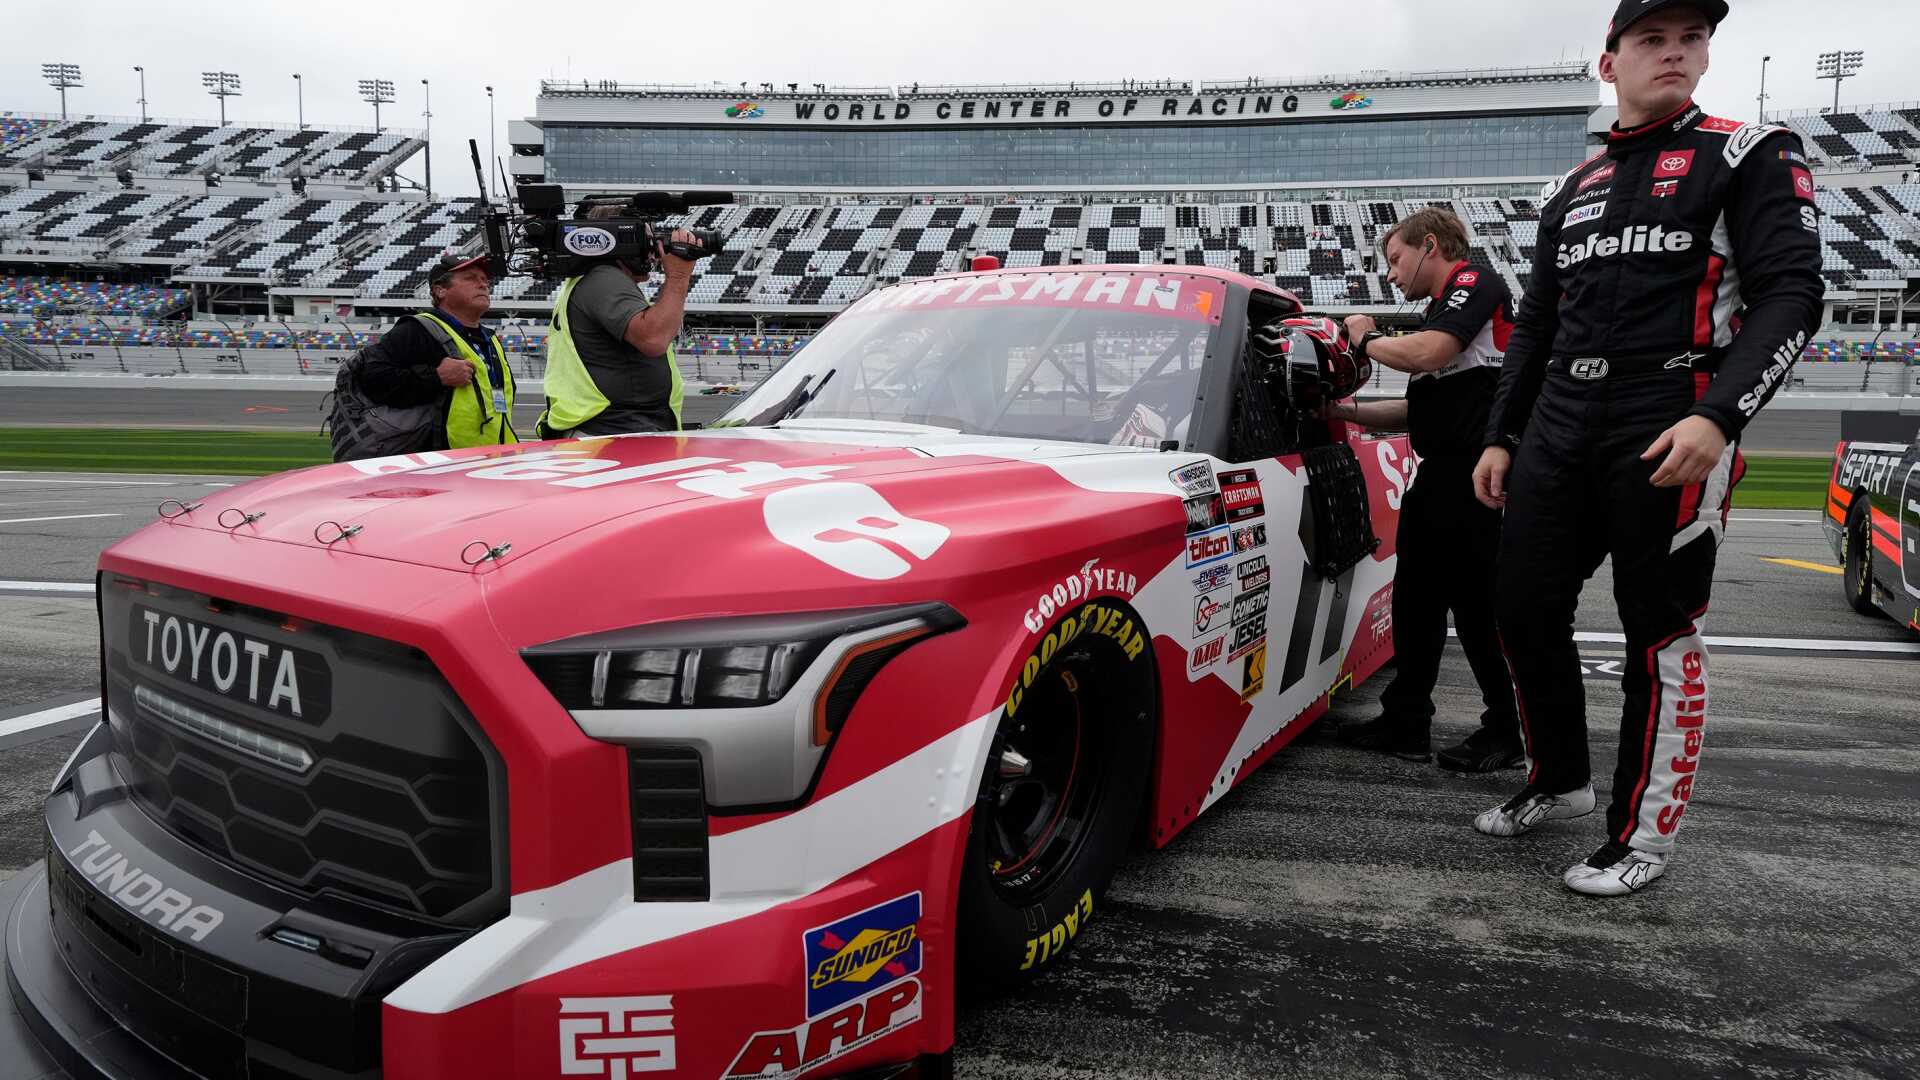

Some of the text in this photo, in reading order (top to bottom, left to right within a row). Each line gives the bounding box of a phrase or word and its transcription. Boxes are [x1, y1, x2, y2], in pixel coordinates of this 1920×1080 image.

[795, 95, 1298, 120] WORLD CENTER OF RACING
[578, 234, 601, 244] FOX
[1556, 224, 1693, 269] Safelite
[1738, 330, 1806, 416] Safelite
[1224, 486, 1260, 504] CRAFTSMAN
[1188, 536, 1230, 561] tilton
[1238, 557, 1266, 578] LINCOLN
[1024, 558, 1137, 634] GOODYEAR
[1233, 590, 1269, 620] COMETIC
[1244, 572, 1269, 590] WELDERS
[1228, 613, 1267, 654] JESEL
[144, 610, 302, 717] TOYOTA
[1007, 604, 1144, 718] GOODYEAR
[1656, 651, 1706, 836] Safelite
[69, 829, 225, 941] TUNDRA
[1020, 887, 1092, 970] EAGLE
[814, 926, 915, 988] SUNOCO
[727, 979, 920, 1076] ARP
